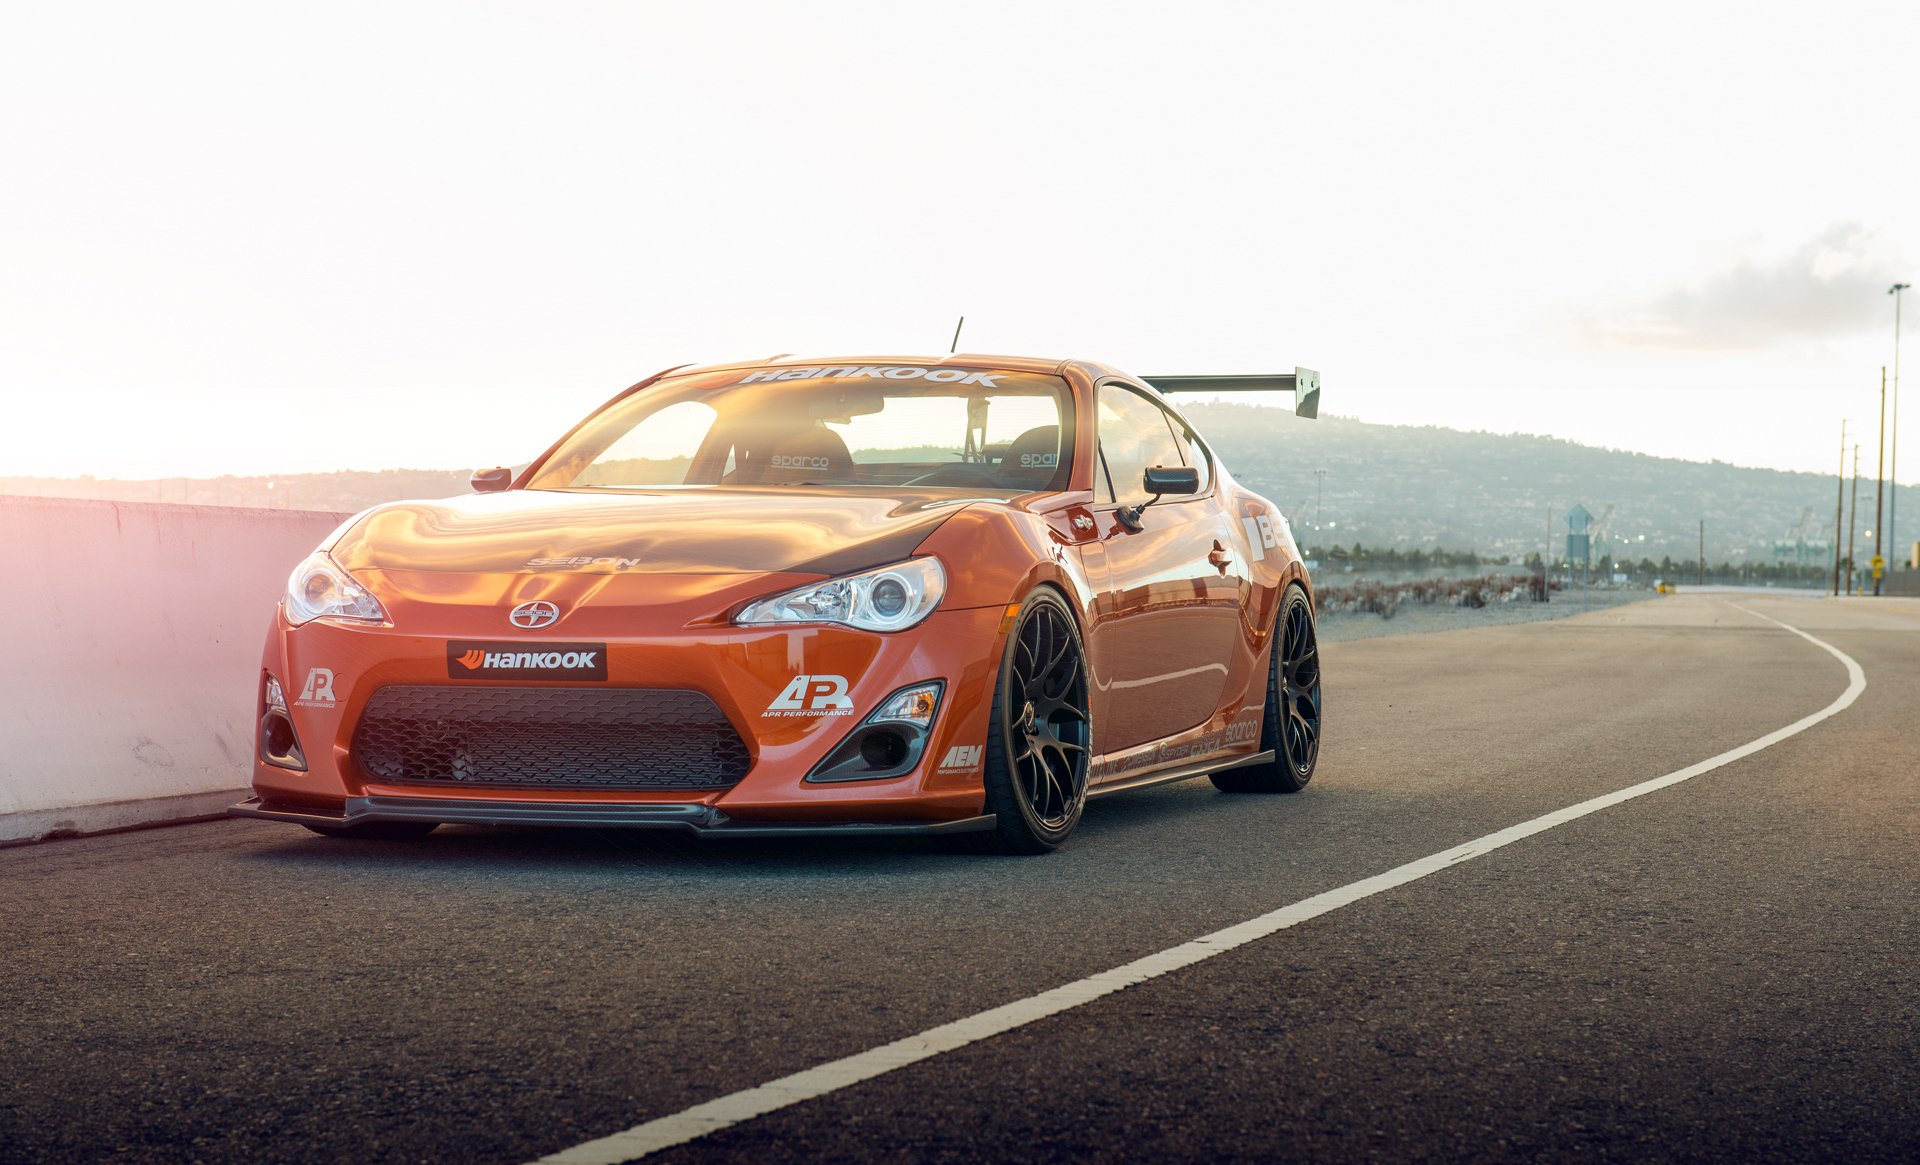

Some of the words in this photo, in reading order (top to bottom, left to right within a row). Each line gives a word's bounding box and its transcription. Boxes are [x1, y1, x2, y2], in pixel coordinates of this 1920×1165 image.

[771, 455, 829, 471] sparco
[527, 556, 640, 566] SEIBON
[767, 675, 854, 710] APR
[1226, 719, 1258, 747] sparco
[940, 744, 982, 768] AEM
